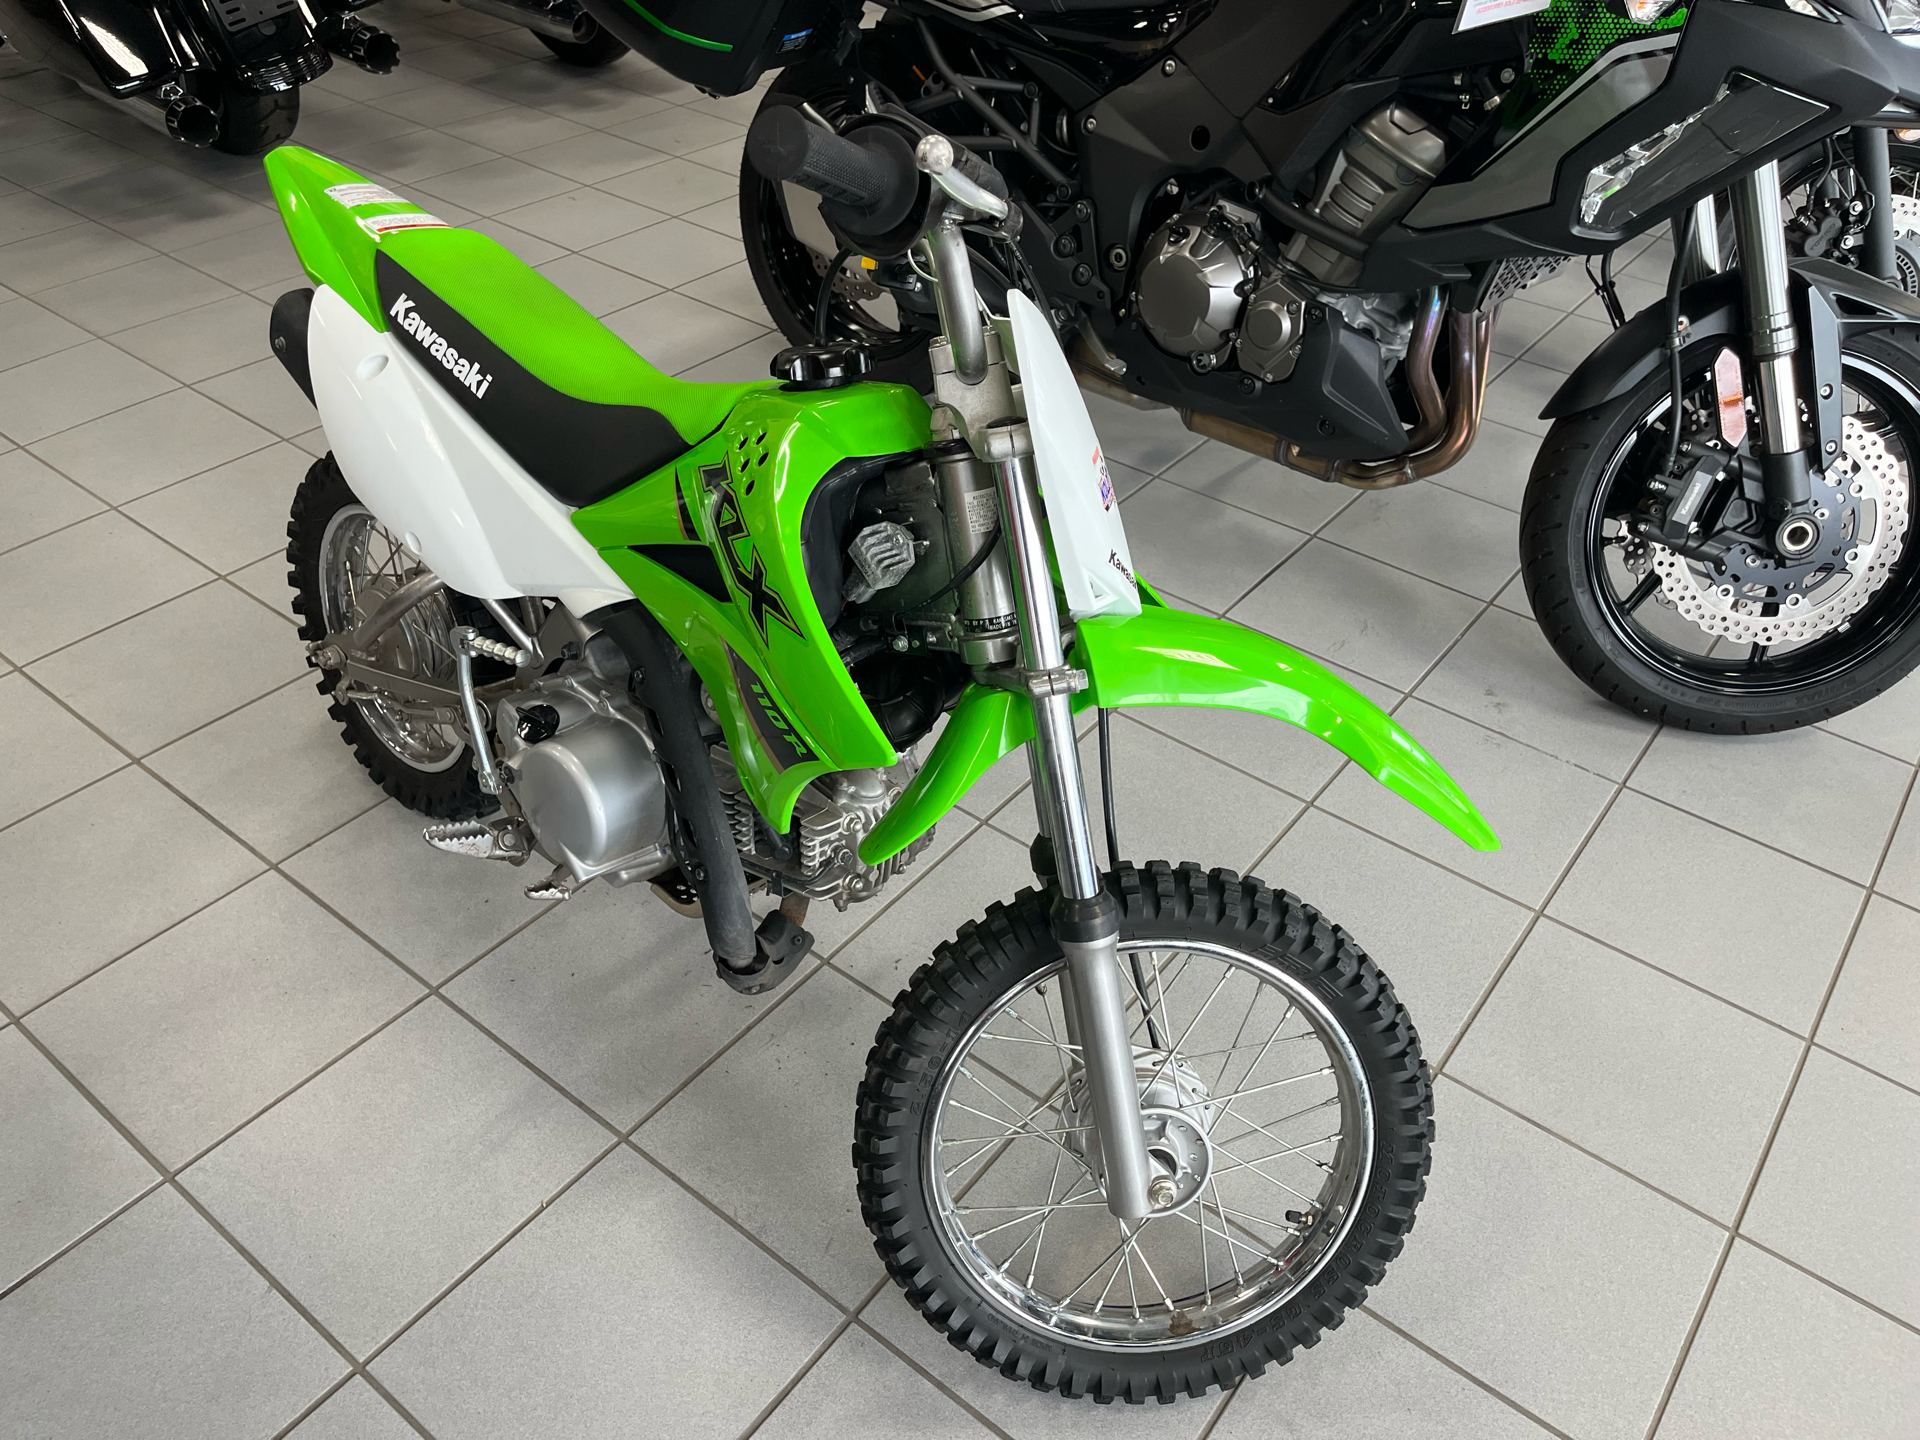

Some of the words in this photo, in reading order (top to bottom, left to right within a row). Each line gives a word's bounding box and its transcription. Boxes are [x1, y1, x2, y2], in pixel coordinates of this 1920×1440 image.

[389, 292, 493, 400] Kawasaki
[699, 451, 807, 650] KLX
[750, 681, 808, 758] 110R
[1309, 1139, 1395, 1300] MOTOCROSS
[1200, 1302, 1301, 1362] GS-45F
